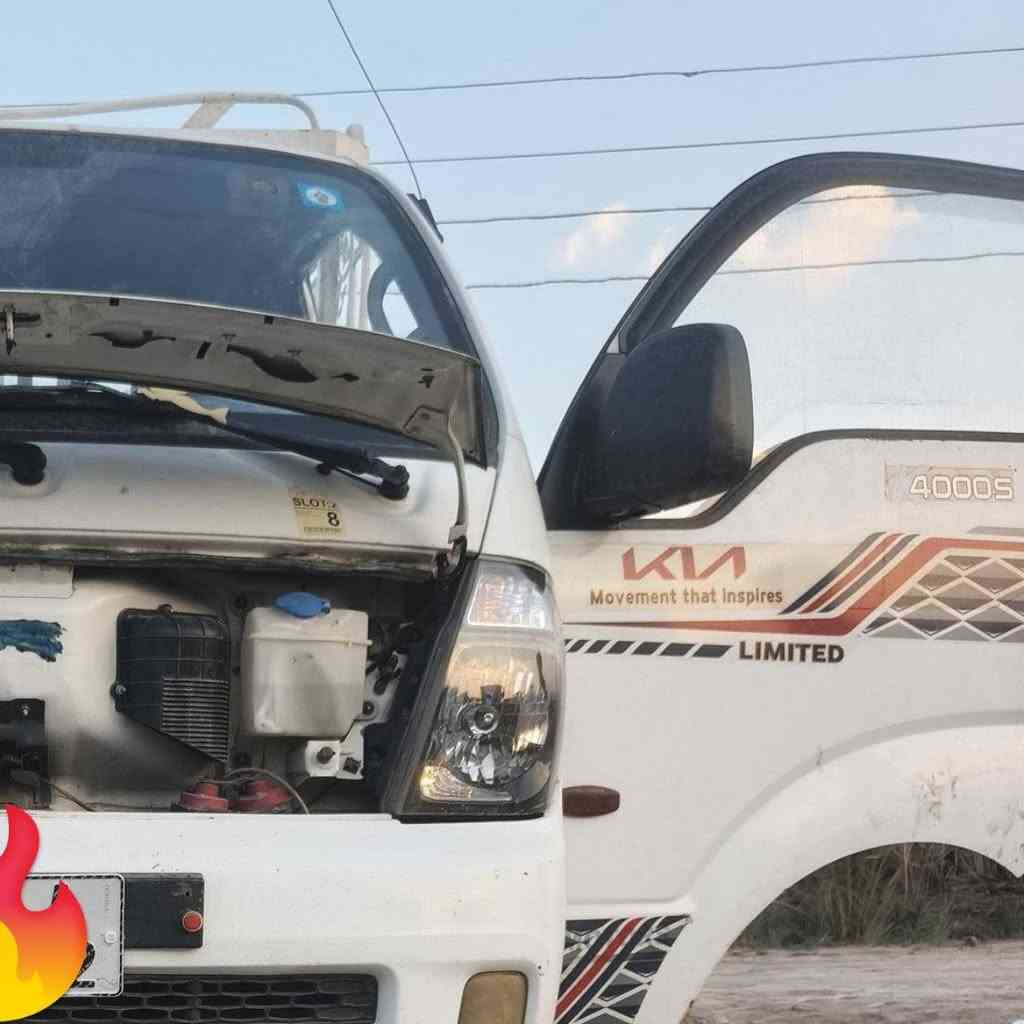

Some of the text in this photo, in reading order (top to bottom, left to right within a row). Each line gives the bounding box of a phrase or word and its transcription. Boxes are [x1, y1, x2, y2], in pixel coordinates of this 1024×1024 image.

[910, 473, 1016, 501] 4000S
[327, 511, 340, 527] 8
[621, 545, 747, 581] KIA
[589, 587, 784, 607] Movement that inspires
[738, 640, 845, 664] LIMITED
